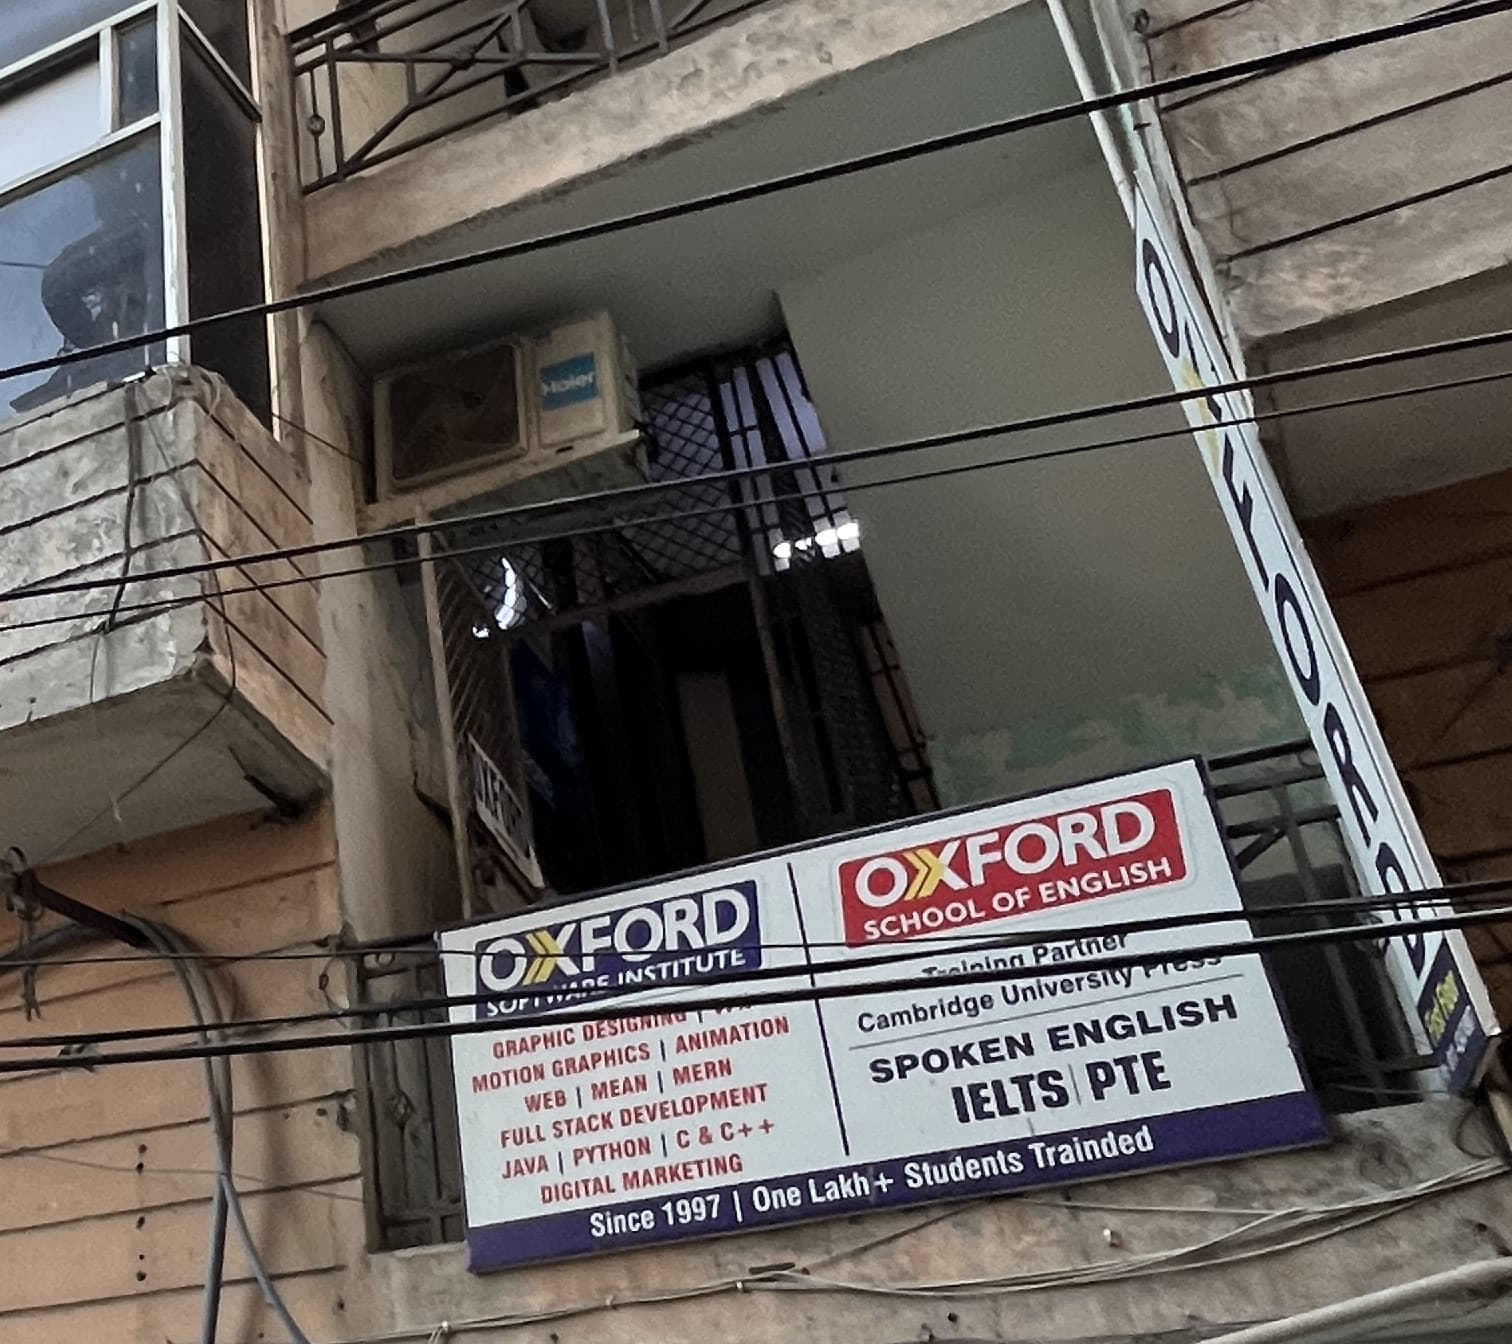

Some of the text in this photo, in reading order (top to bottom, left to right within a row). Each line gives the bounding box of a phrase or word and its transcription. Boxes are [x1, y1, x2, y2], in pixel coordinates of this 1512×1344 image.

[855, 802, 1155, 908] OXFORD
[864, 857, 1173, 941] SCHOOL OF ENGLISH
[479, 888, 750, 991] OXFORD
[618, 948, 746, 986] INSTITUTE
[1032, 932, 1128, 964] Partner
[858, 993, 995, 1033] Cambridge
[1001, 966, 1133, 1006] University
[472, 1016, 790, 1093] MOTION GRAPHICS ANIMATION
[493, 1027, 576, 1058] GRAPHIC
[868, 994, 1239, 1084] SPOKEN ENGLISH
[501, 1083, 768, 1148] FULL STACK DEVELOPMENT
[524, 1058, 733, 1113] WEB MEAN MERN
[951, 1051, 1172, 1123] IELTS PTE
[502, 1155, 549, 1179] JAVA
[573, 1136, 651, 1167] PYTHON
[677, 1129, 690, 1149] C
[699, 1125, 713, 1146] &
[541, 1153, 743, 1204] DIGITAL MARKETING
[590, 1210, 656, 1237] Since
[663, 1192, 721, 1225] 1997
[753, 1185, 804, 1213] One
[904, 1151, 1024, 1189] Students
[1028, 1125, 1154, 1170] Trainded
